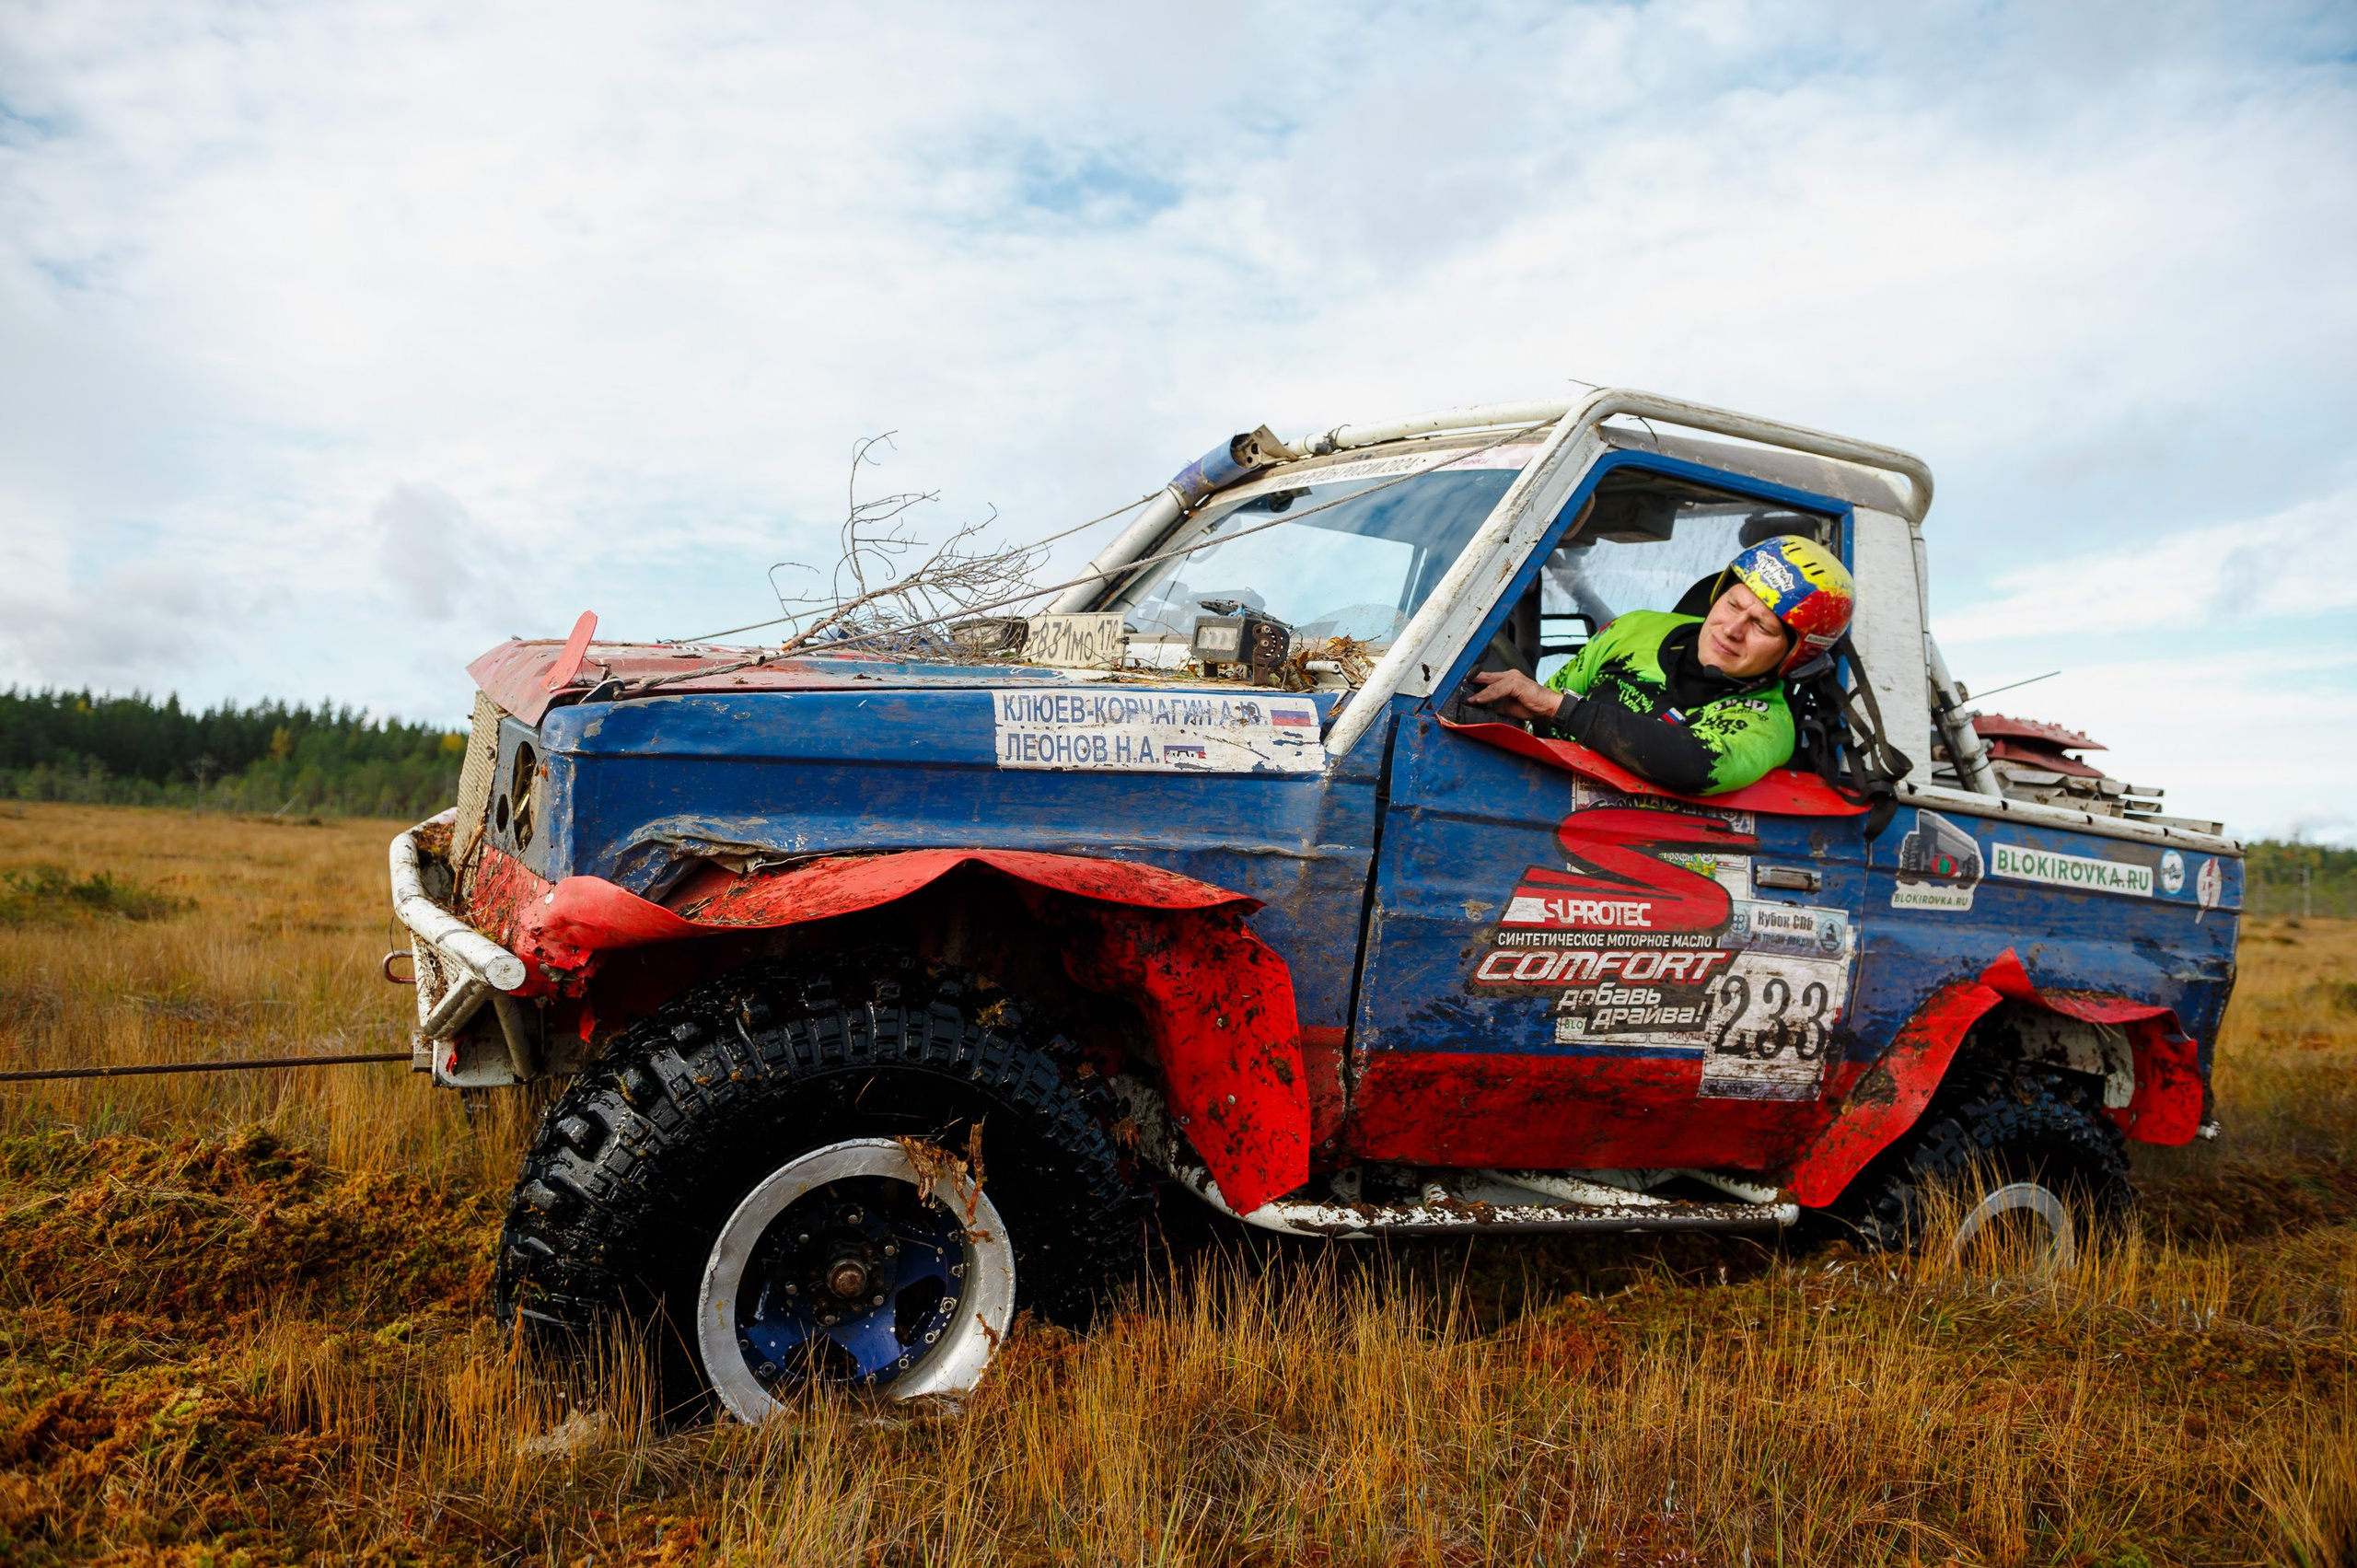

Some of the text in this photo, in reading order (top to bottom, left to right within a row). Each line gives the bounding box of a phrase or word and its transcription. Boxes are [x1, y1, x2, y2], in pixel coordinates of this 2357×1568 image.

[1097, 619, 1119, 651] 178
[1005, 733, 1160, 763] ЛЕОНОВ Н.А.
[1996, 849, 2150, 891] BLOKIROVKA.RU
[1543, 899, 1652, 927] SUPROTEC
[1893, 893, 1968, 907] BLOKIROVKA.RU
[1758, 911, 1791, 928] Кубок
[1497, 932, 1713, 948] СИНТЕТИЧЕСКОЕ МОТОРНОЕ МАСЛО
[1476, 951, 1727, 981] COMFORT
[1556, 981, 1662, 1011] добавь
[1713, 975, 1829, 1061] 233
